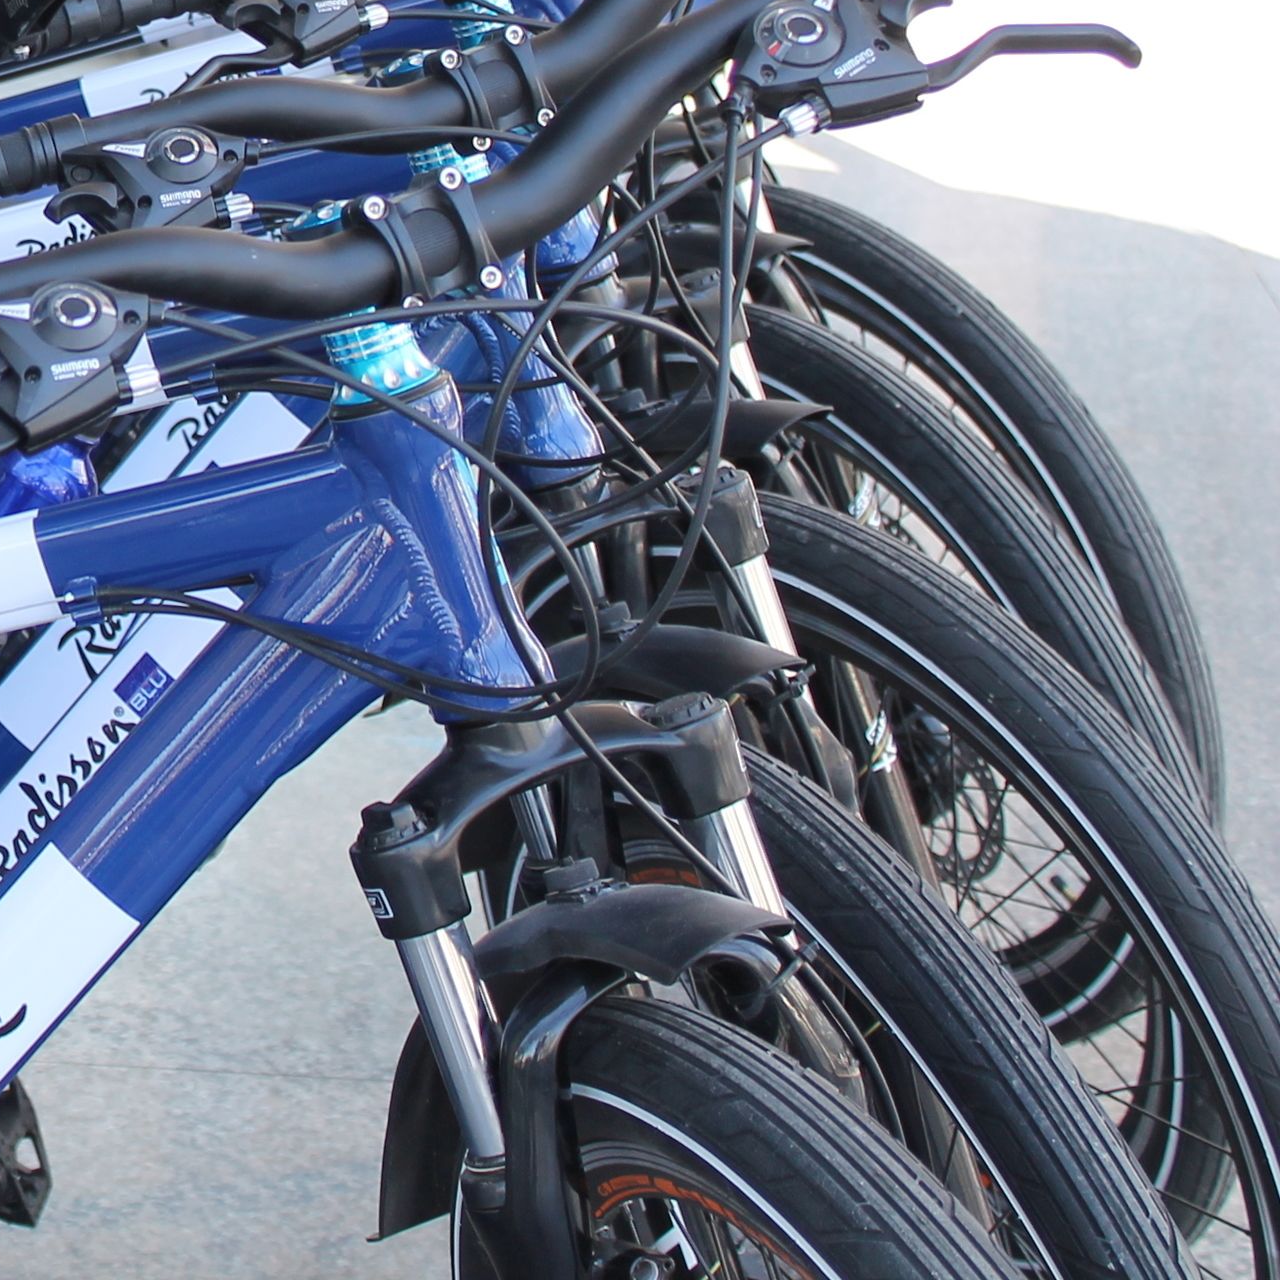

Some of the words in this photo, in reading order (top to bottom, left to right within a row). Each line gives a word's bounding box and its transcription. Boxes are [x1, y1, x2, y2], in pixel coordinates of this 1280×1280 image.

[160, 189, 202, 203] SHIMANO
[50, 357, 101, 376] SHIMANO
[129, 669, 168, 713] BLU
